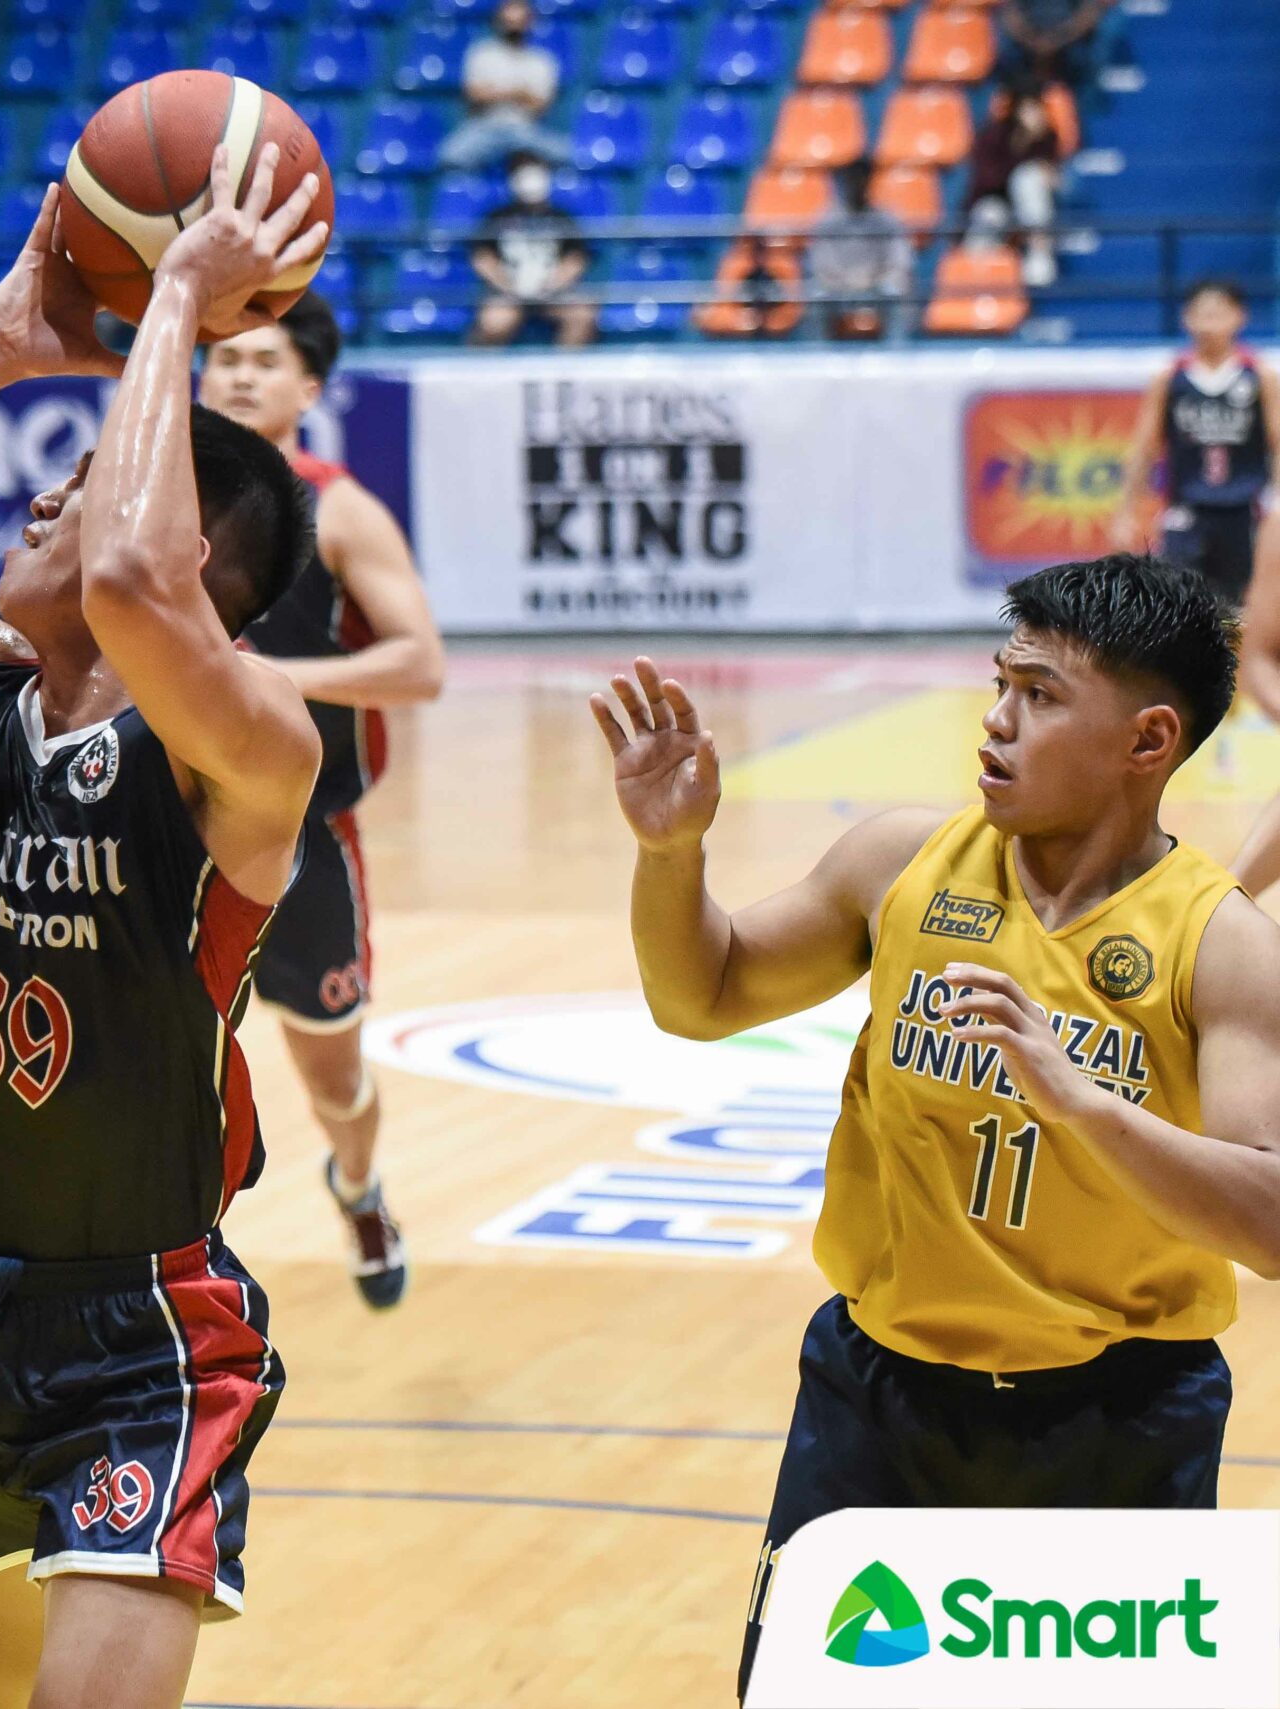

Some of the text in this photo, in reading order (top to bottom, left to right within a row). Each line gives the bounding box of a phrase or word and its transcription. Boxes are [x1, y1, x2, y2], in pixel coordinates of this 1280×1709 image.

[527, 500, 747, 561] KING
[899, 970, 1152, 1082] JOS IZAL
[968, 1113, 1039, 1230] 11
[72, 1454, 154, 1534] 39
